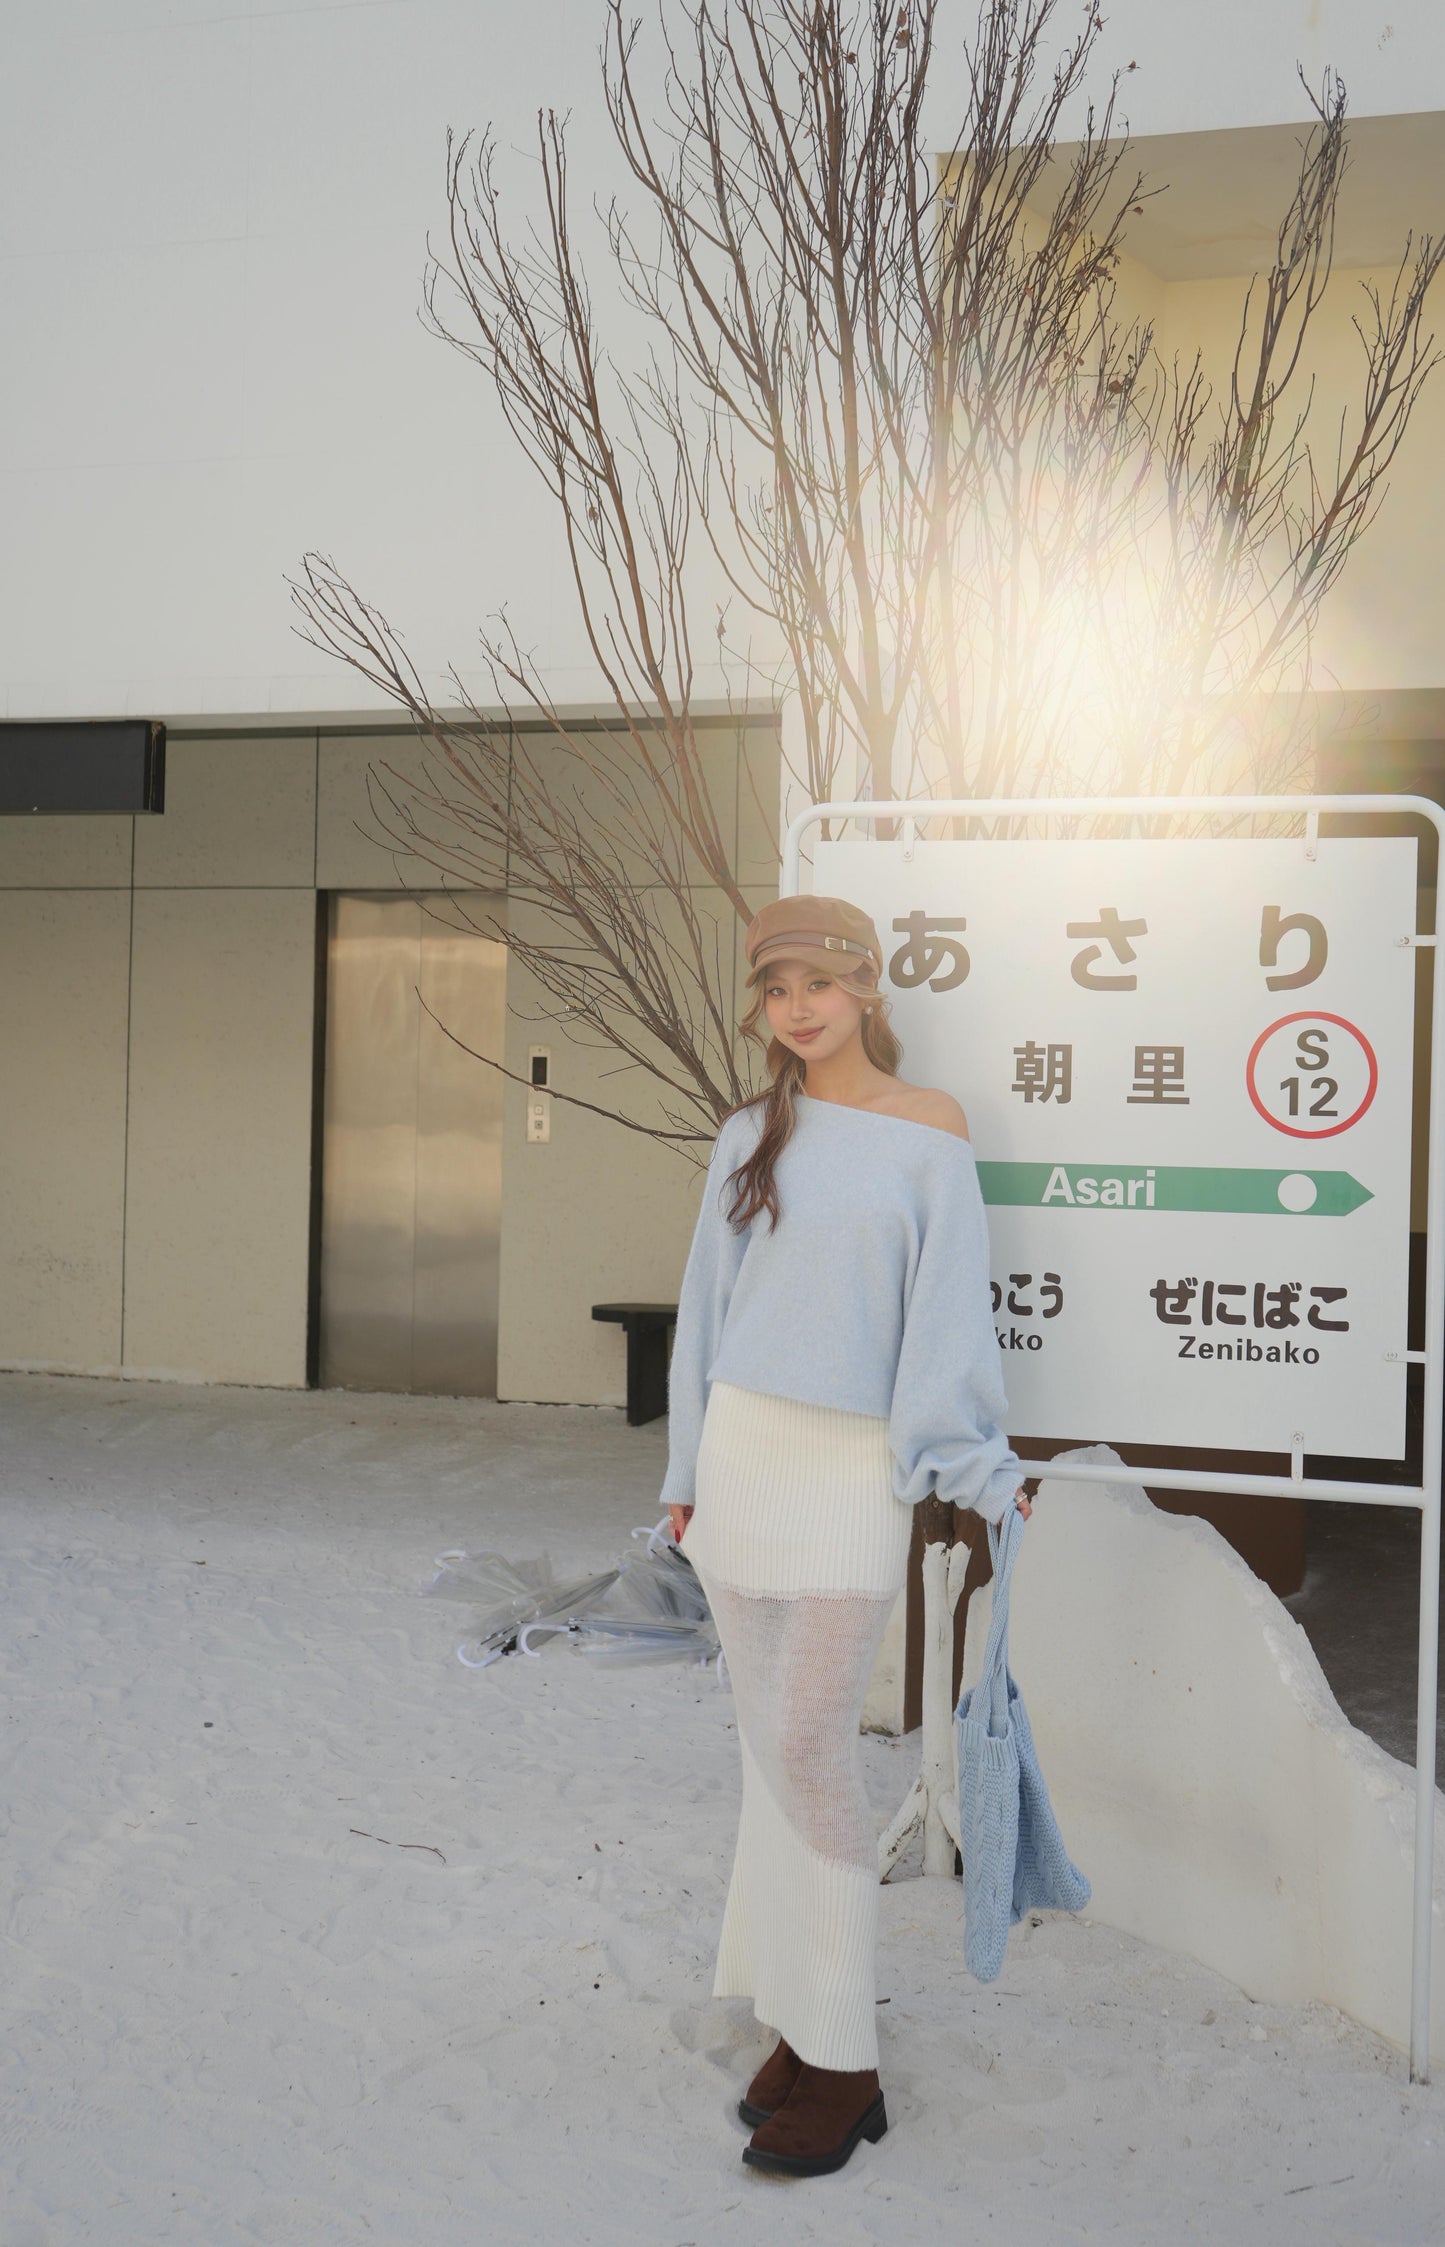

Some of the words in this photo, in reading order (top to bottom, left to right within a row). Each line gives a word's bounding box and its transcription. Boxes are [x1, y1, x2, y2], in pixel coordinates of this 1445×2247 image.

[889, 905, 1329, 992] あさり
[1296, 1029, 1330, 1070] S
[1011, 1041, 1191, 1105] 朝里
[1279, 1077, 1339, 1117] 12
[1041, 1167, 1156, 1207] Asari
[1149, 1277, 1350, 1332] ぜにばこ
[1178, 1335, 1320, 1365] Zenibako
